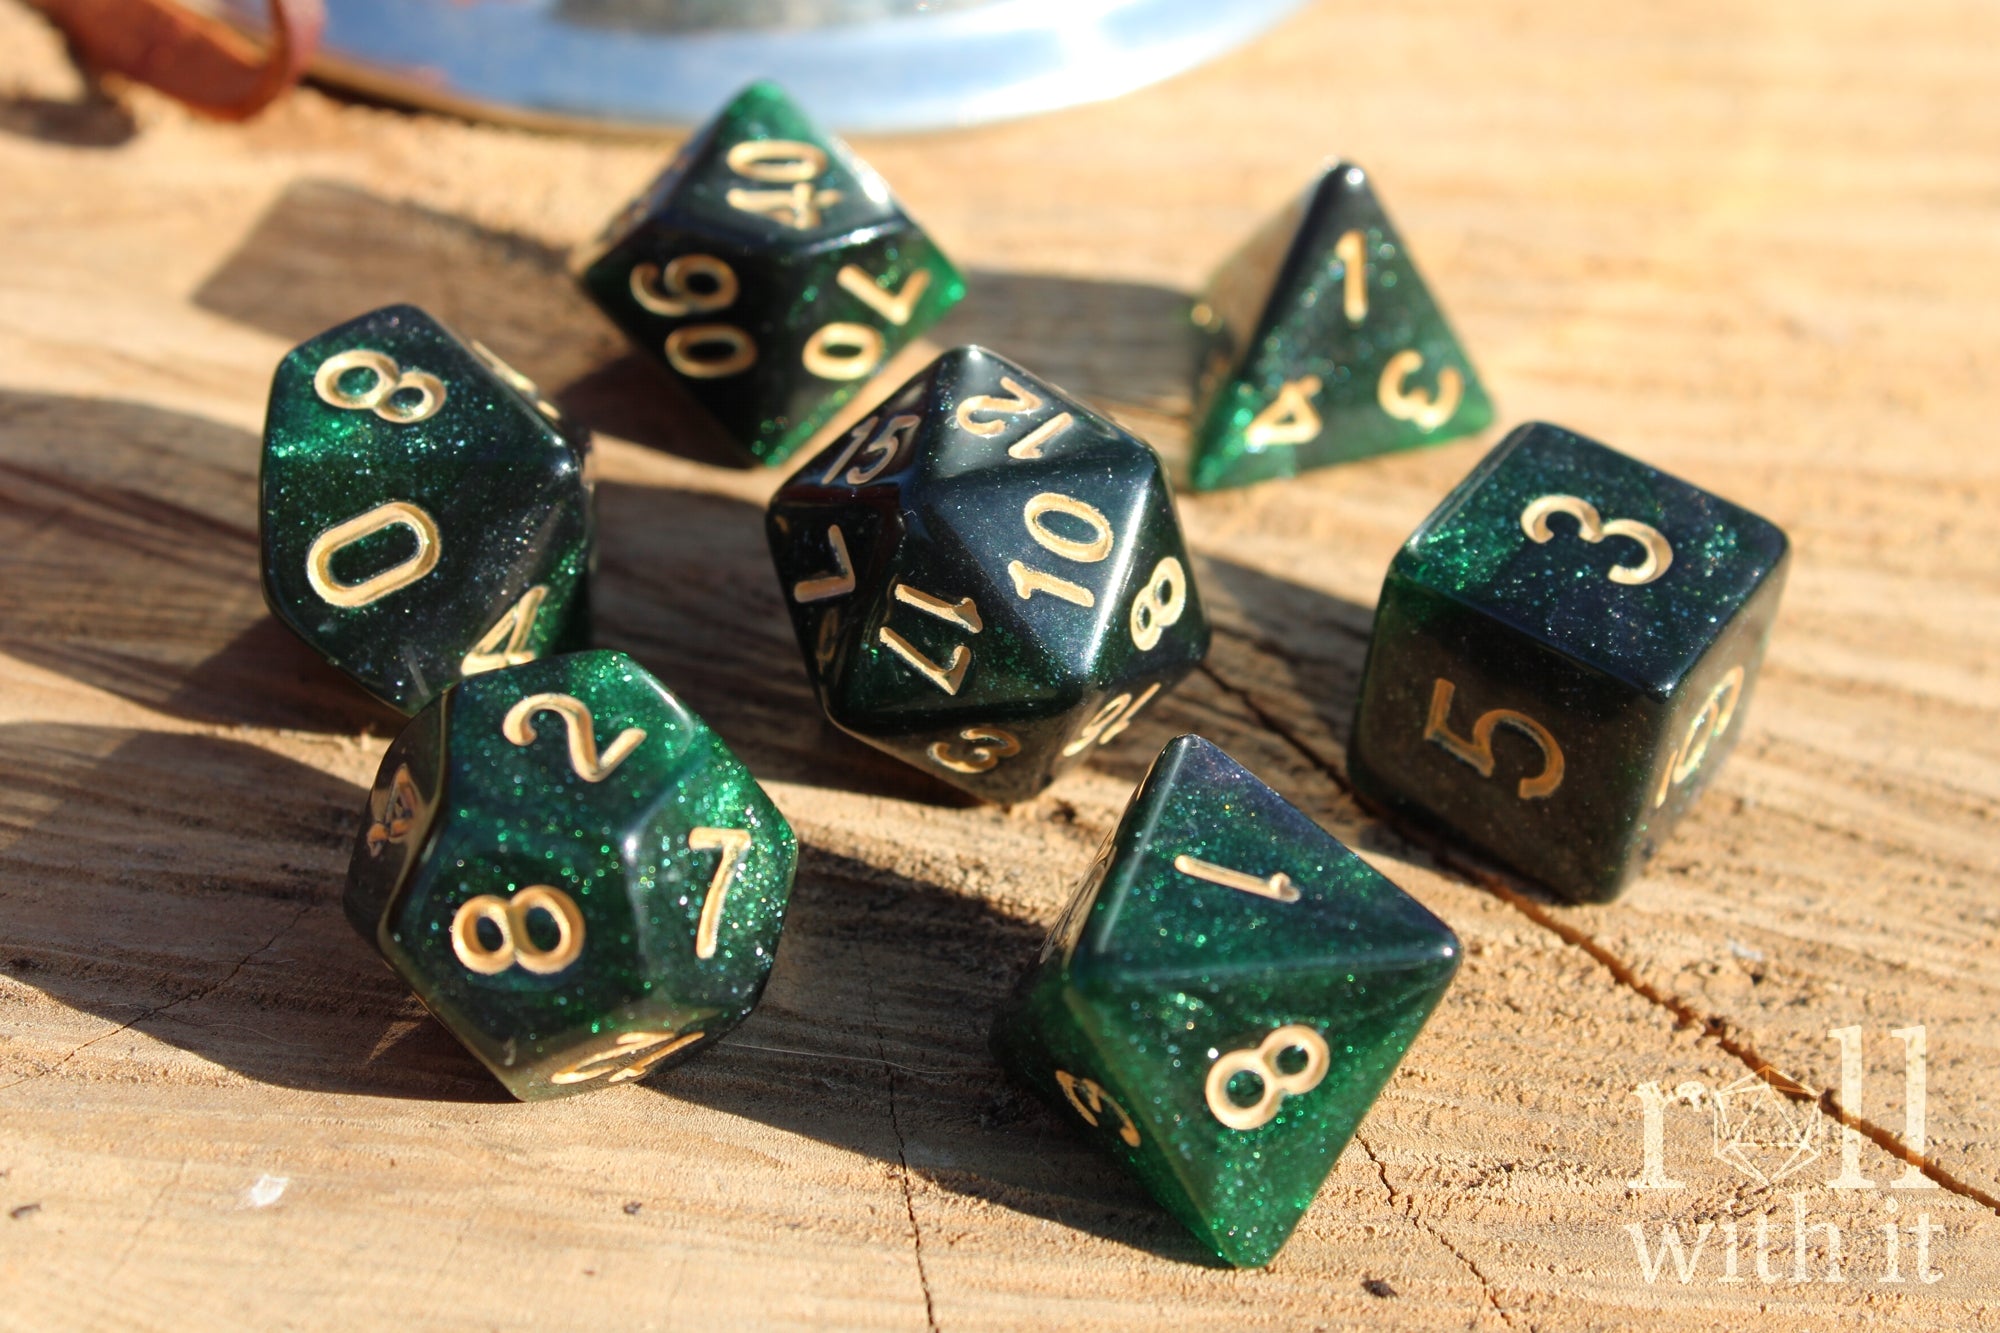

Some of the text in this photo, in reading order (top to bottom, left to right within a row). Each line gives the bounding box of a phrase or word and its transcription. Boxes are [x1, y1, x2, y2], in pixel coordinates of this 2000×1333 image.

[726, 138, 842, 231] 40
[1335, 230, 1369, 322] 1
[314, 349, 447, 424] 8
[957, 377, 1074, 460] 12
[1245, 375, 1323, 451] 4
[1377, 350, 1464, 429] 3
[820, 415, 921, 485] 15
[306, 501, 442, 608] 0
[794, 524, 857, 604] 7
[1008, 492, 1114, 608] 10
[1520, 494, 1674, 586] 3
[461, 585, 549, 676] 4
[879, 583, 984, 697] 17
[1130, 556, 1187, 652] 8
[503, 693, 648, 782] 2
[927, 727, 1022, 775] 3
[1424, 678, 1566, 800] 5
[688, 827, 752, 959] 7
[1174, 854, 1301, 903] 1
[451, 884, 585, 976] 8
[1055, 1068, 1142, 1149] 3
[1205, 1024, 1330, 1131] 8
